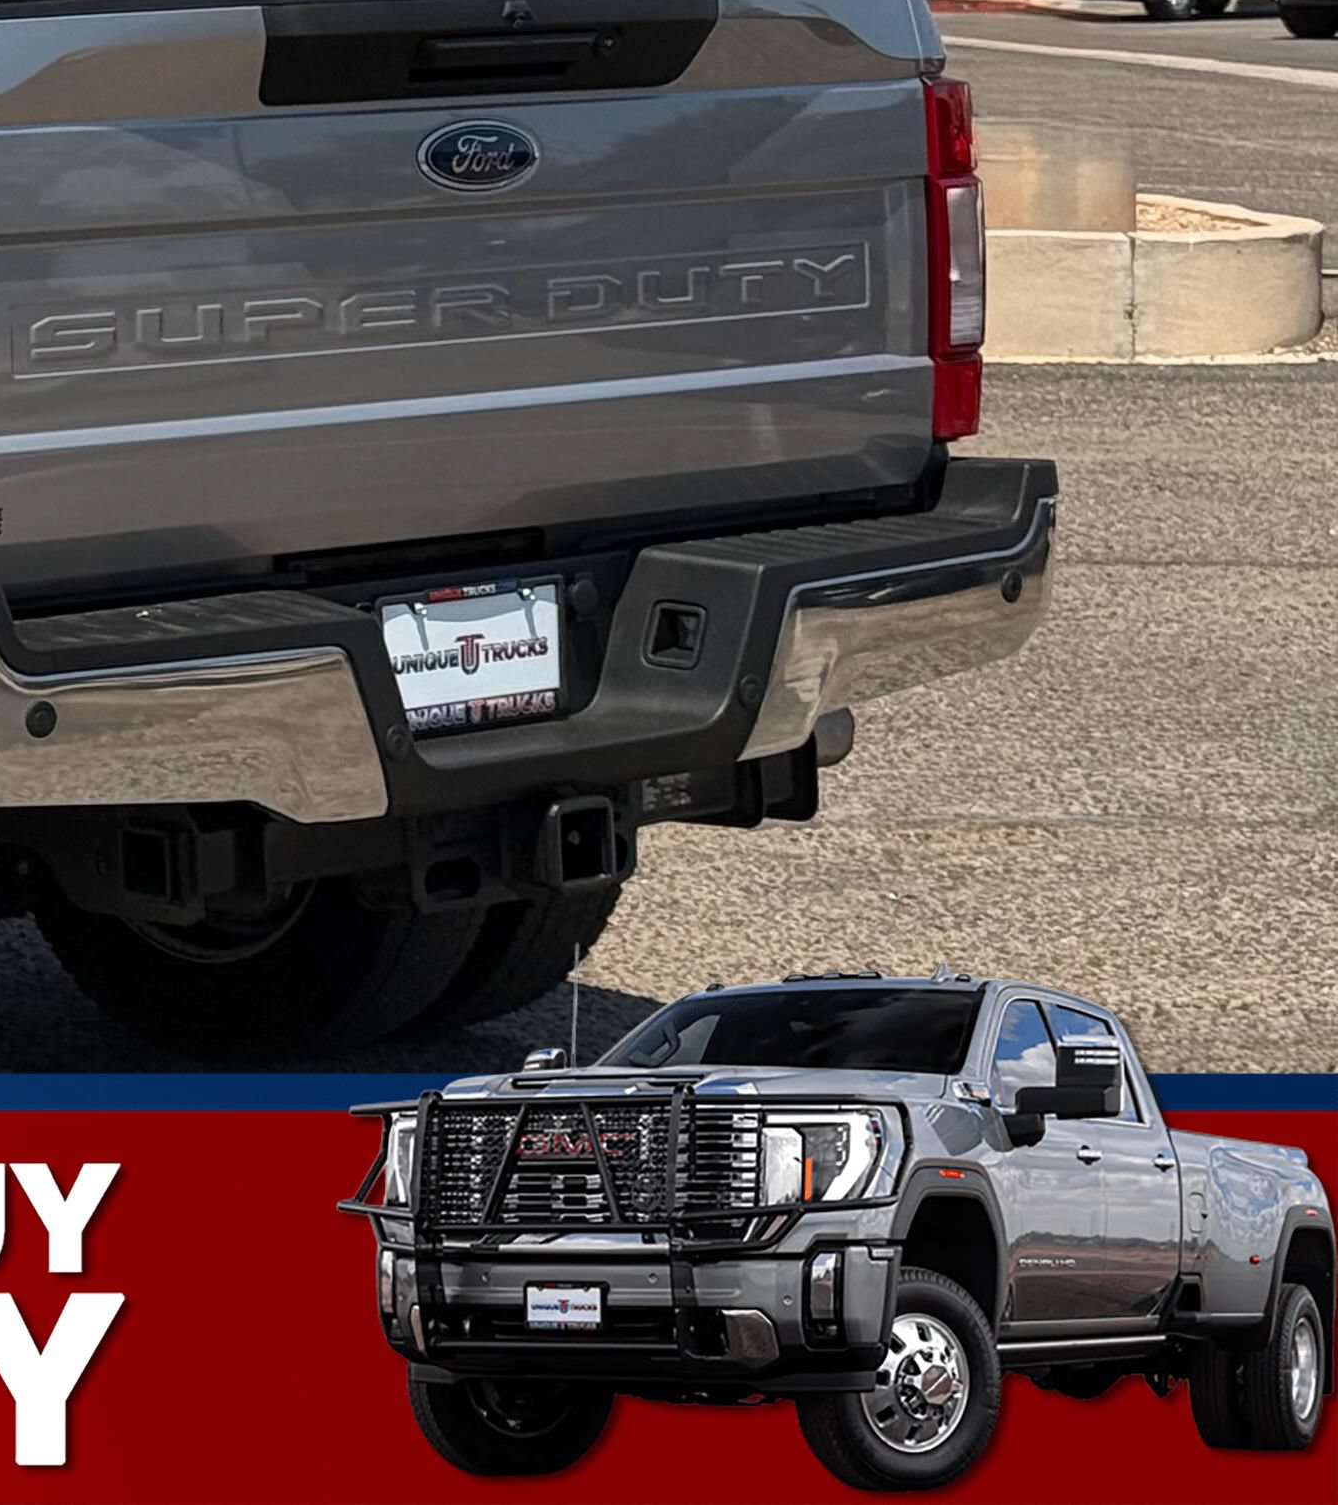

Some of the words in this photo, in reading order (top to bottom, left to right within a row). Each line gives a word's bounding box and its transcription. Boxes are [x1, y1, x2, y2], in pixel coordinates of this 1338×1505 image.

[451, 134, 514, 173] Ford
[27, 281, 513, 364] SUPER
[546, 254, 857, 321] DUTY
[393, 648, 460, 674] UNIQUE
[481, 636, 549, 664] TRUCKS
[486, 691, 556, 719] TRUCKS
